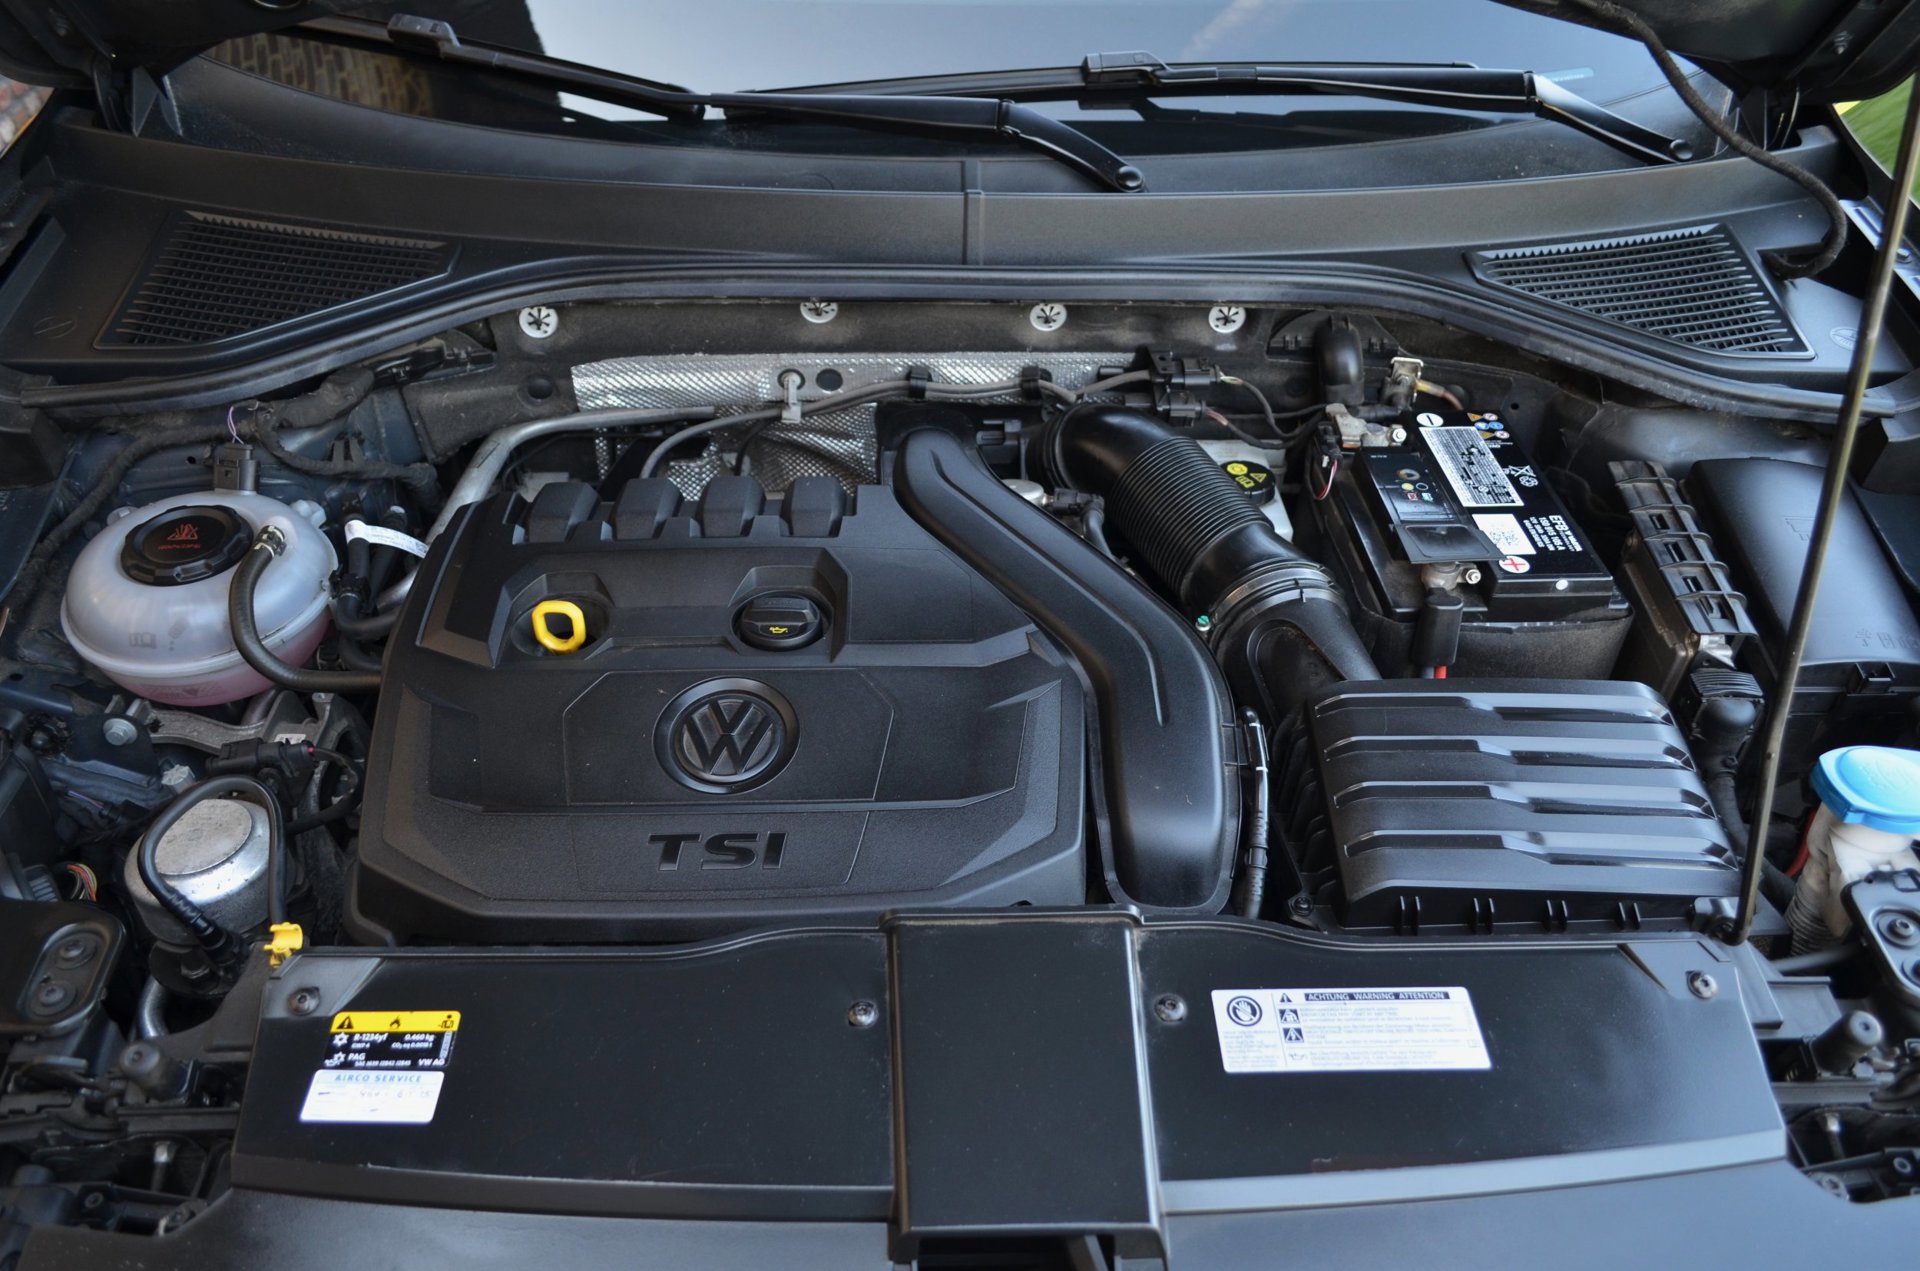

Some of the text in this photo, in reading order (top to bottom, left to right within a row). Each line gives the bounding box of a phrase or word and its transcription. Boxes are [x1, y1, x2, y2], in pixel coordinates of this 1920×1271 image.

[1549, 515, 1570, 531] EFB
[648, 832, 788, 871] TSI
[1308, 990, 1445, 1001] ACHTUNG WARNING ATTENTION
[353, 1033, 389, 1043] R-1234yf
[348, 1052, 366, 1061] PAG
[418, 1058, 433, 1067] VW
[431, 1058, 446, 1067] AG
[335, 1074, 422, 1083] AIRCO SERVICE
